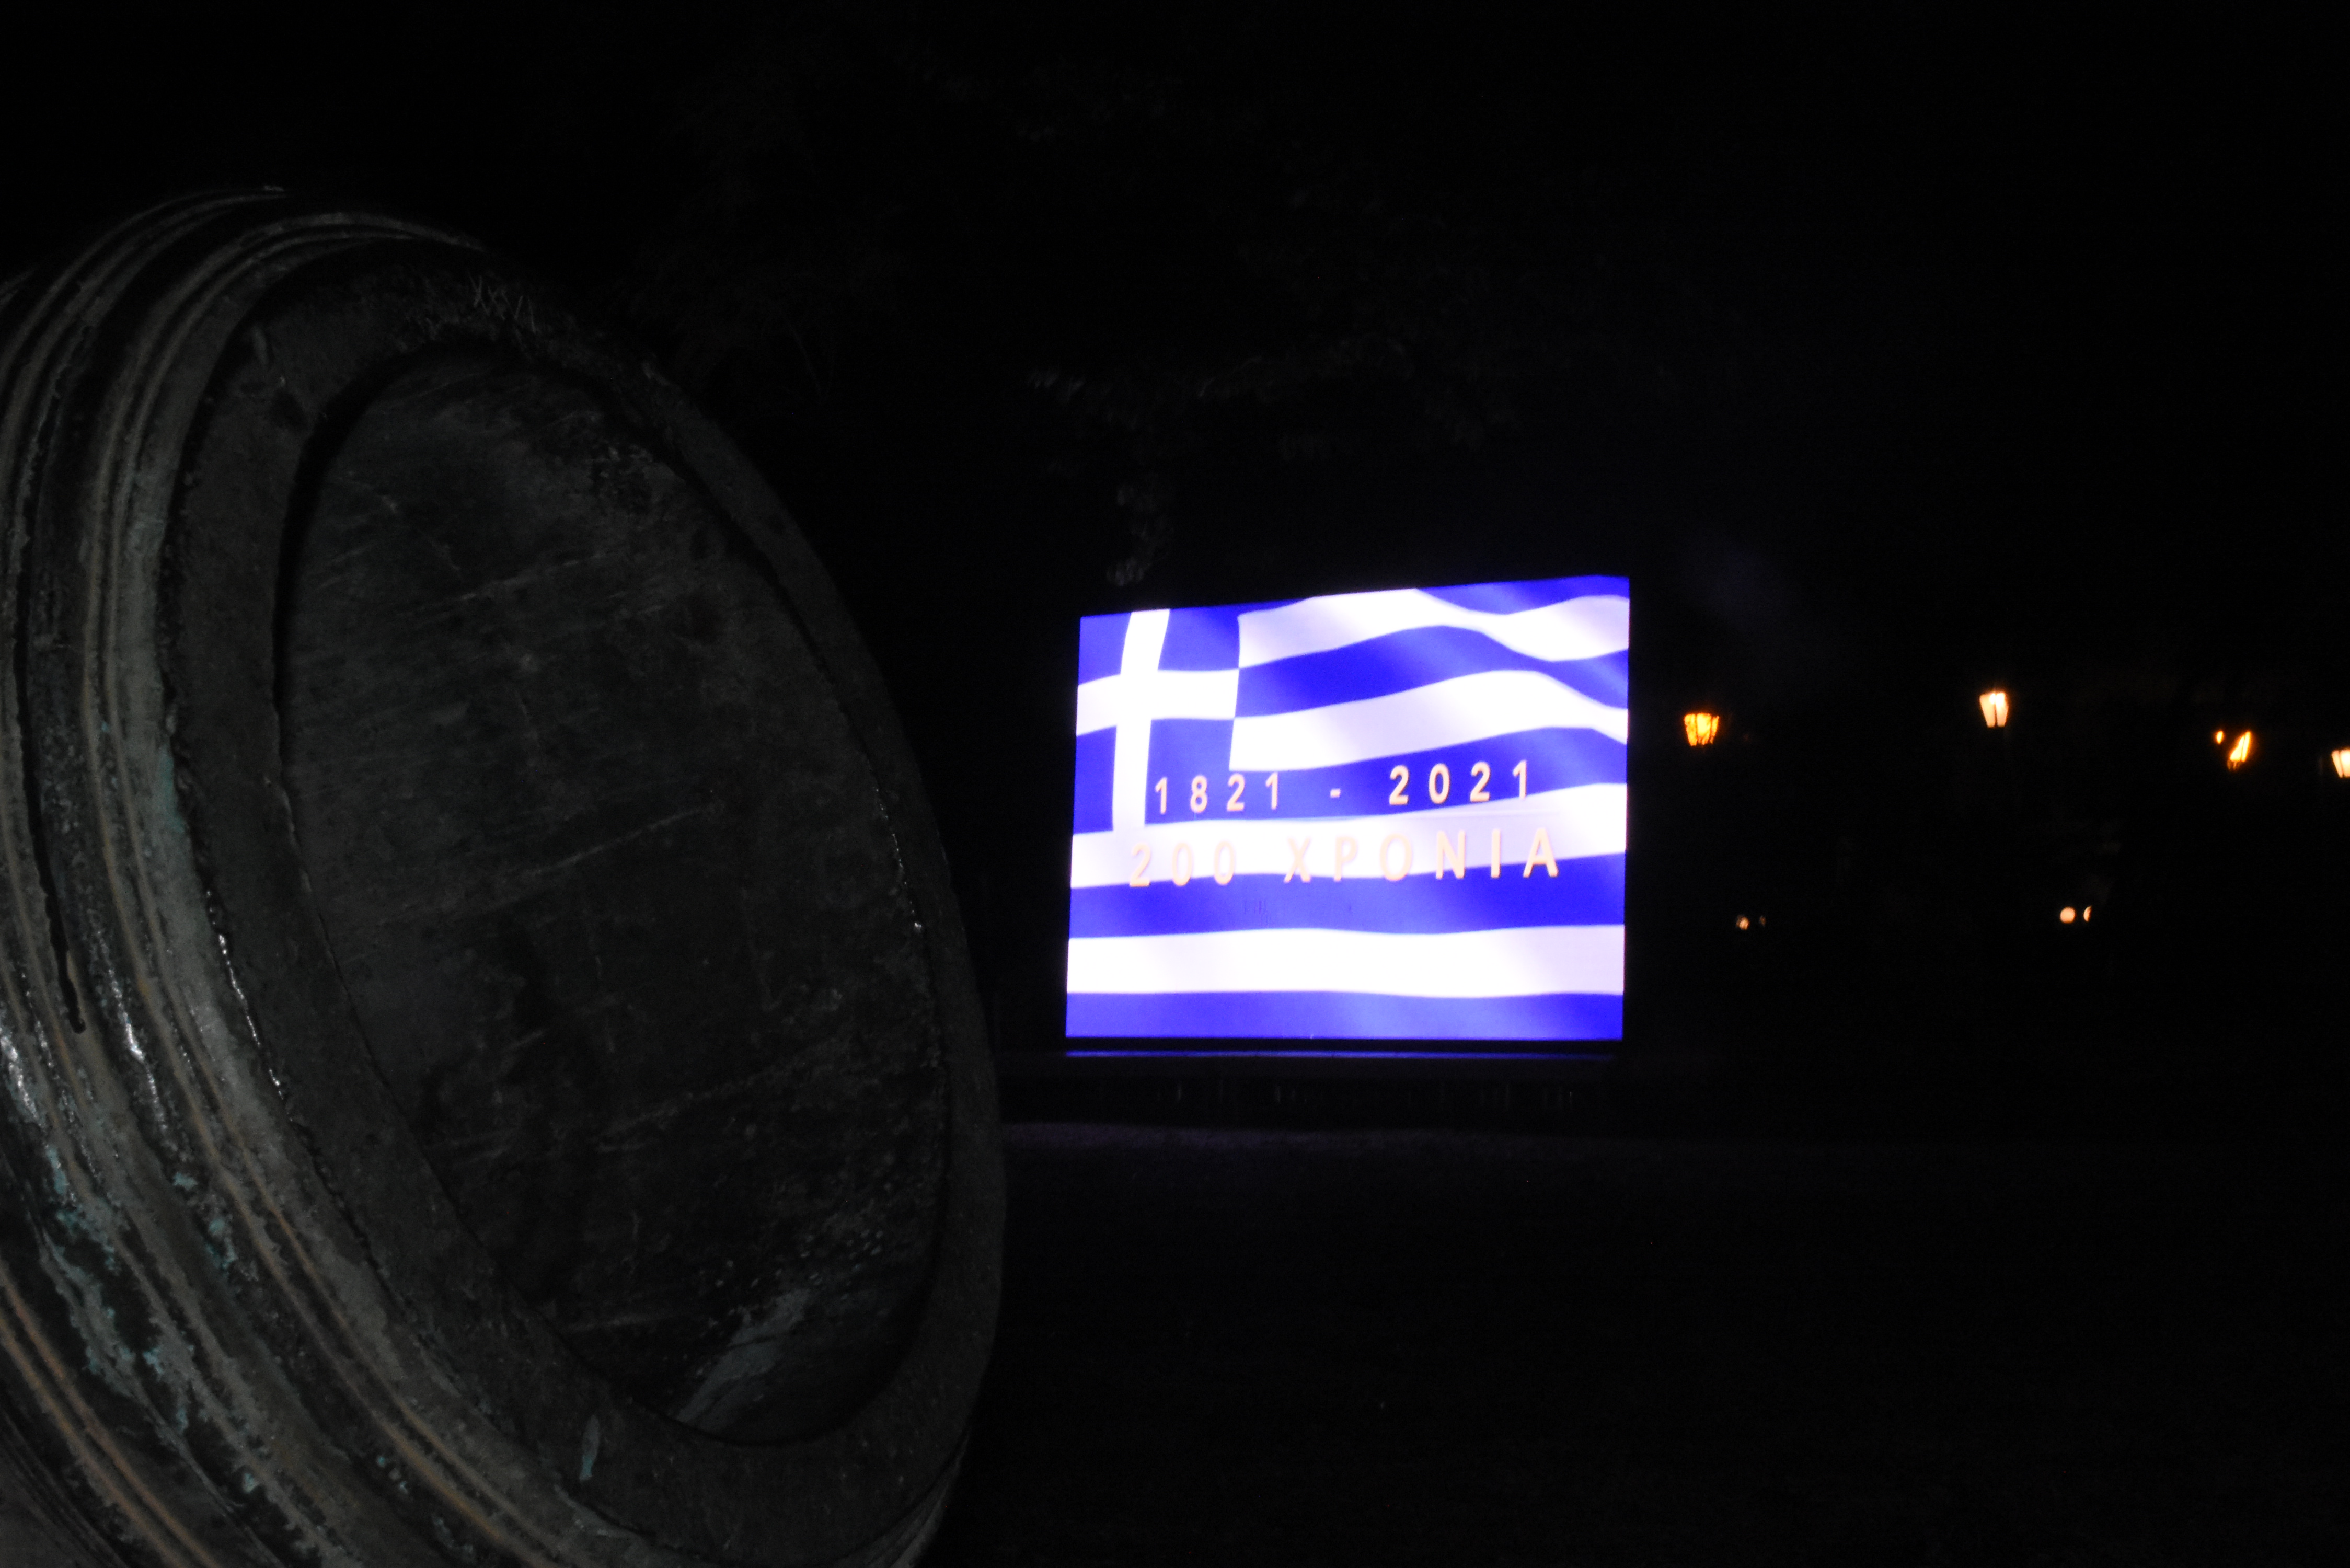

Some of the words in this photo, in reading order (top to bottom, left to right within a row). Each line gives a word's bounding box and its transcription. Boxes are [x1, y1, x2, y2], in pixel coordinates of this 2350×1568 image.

[1155, 771, 1278, 814] 1821
[1330, 788, 1341, 798] -
[1389, 759, 1527, 805] 2021
[1129, 840, 1236, 887] 200
[1283, 827, 1559, 882] ΧΡΟΝΙΑ
